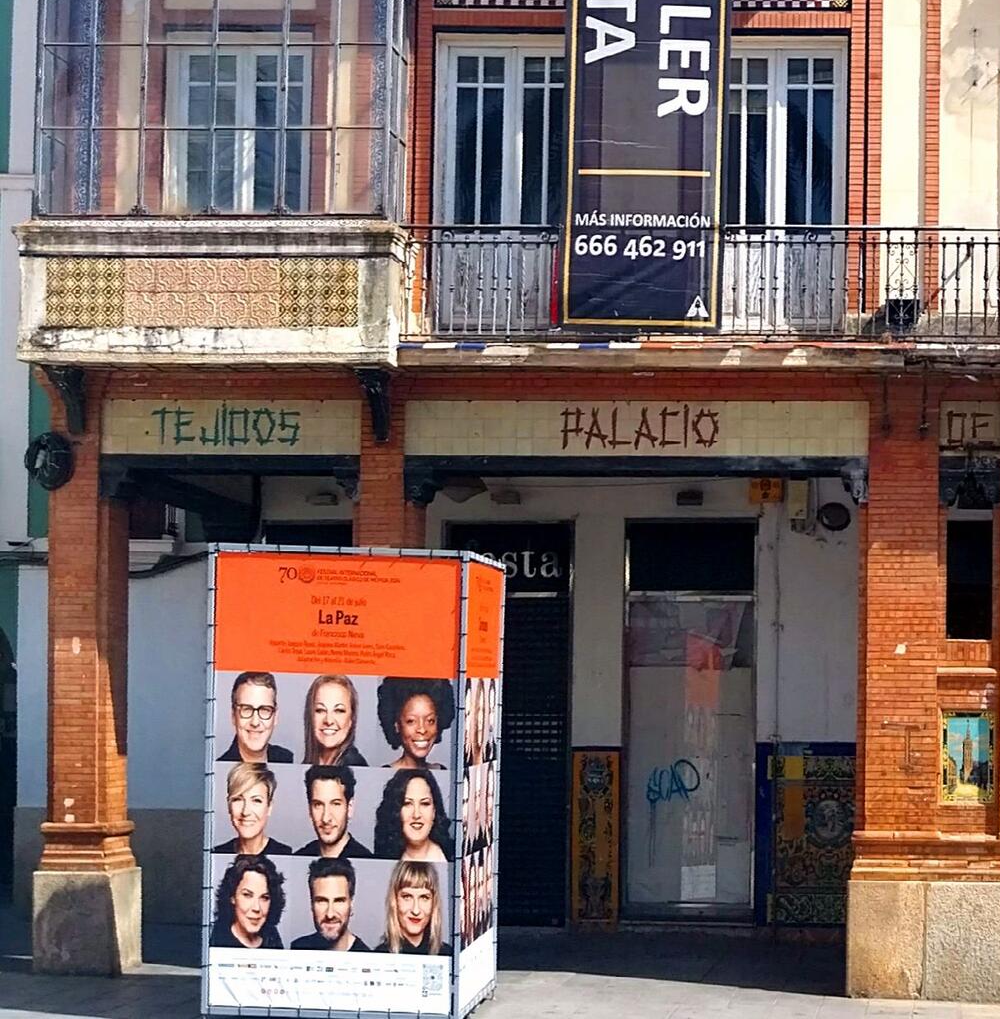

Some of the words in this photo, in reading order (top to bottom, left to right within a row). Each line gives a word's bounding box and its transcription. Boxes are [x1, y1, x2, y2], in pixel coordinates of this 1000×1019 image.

[575, 210, 607, 226] MÁS
[610, 212, 711, 228] INFORMACIÓN
[574, 234, 618, 256] 666
[623, 235, 666, 260] 462
[672, 240, 705, 260] 911
[152, 404, 300, 446] TEJIDOS
[560, 404, 719, 450] PALACIO
[279, 567, 298, 583] 70
[318, 609, 333, 625] La
[335, 610, 359, 626] Paz
